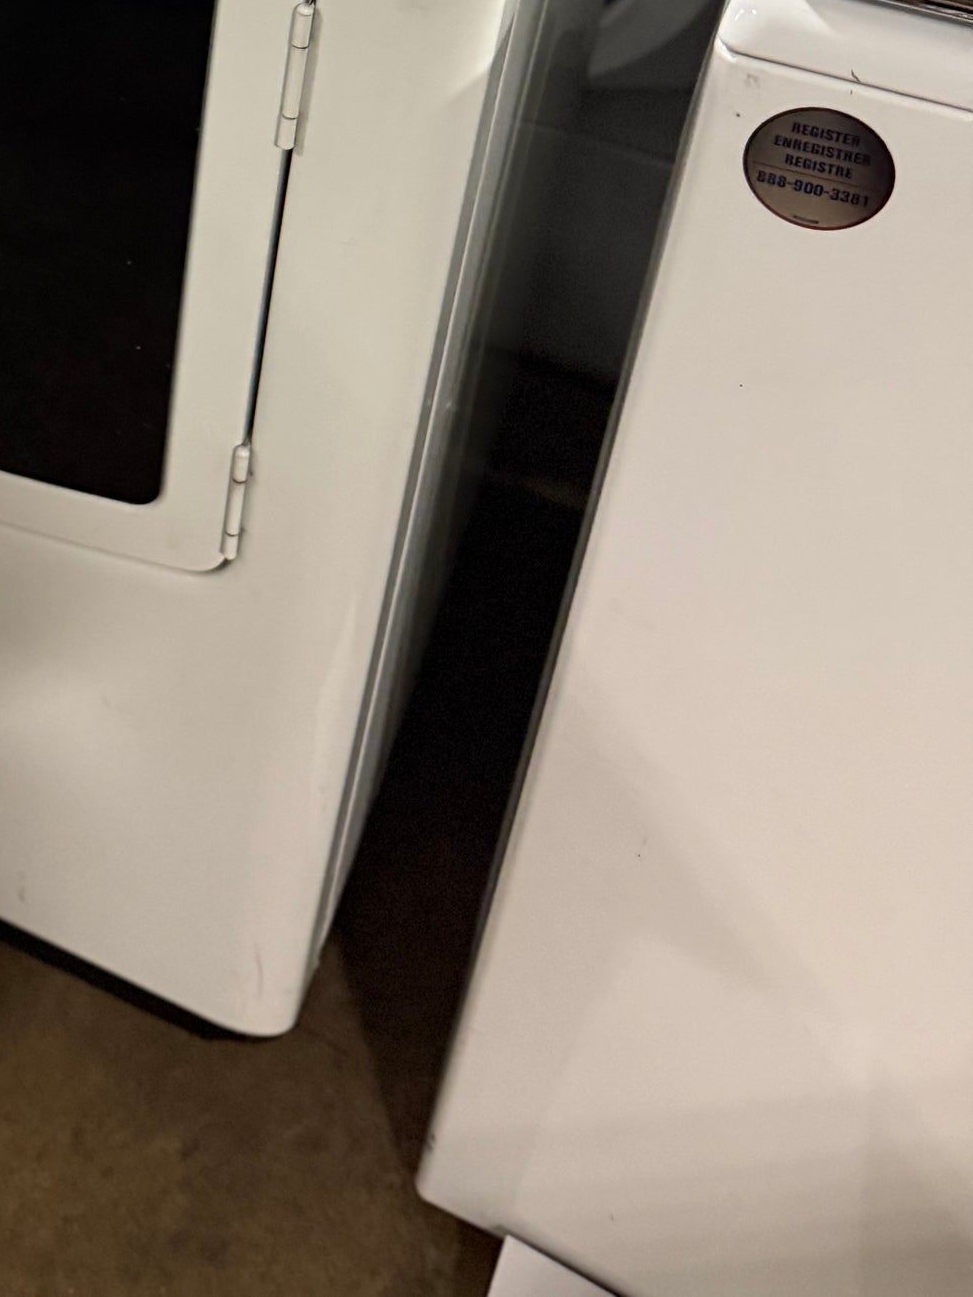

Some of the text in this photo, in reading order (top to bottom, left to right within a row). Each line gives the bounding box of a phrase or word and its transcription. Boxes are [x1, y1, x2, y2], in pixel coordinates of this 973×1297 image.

[792, 121, 860, 147] REGISTER
[774, 134, 871, 166] ENREGISTRER
[785, 153, 853, 179] REGISTRE
[756, 169, 870, 208] 888-900-3381
